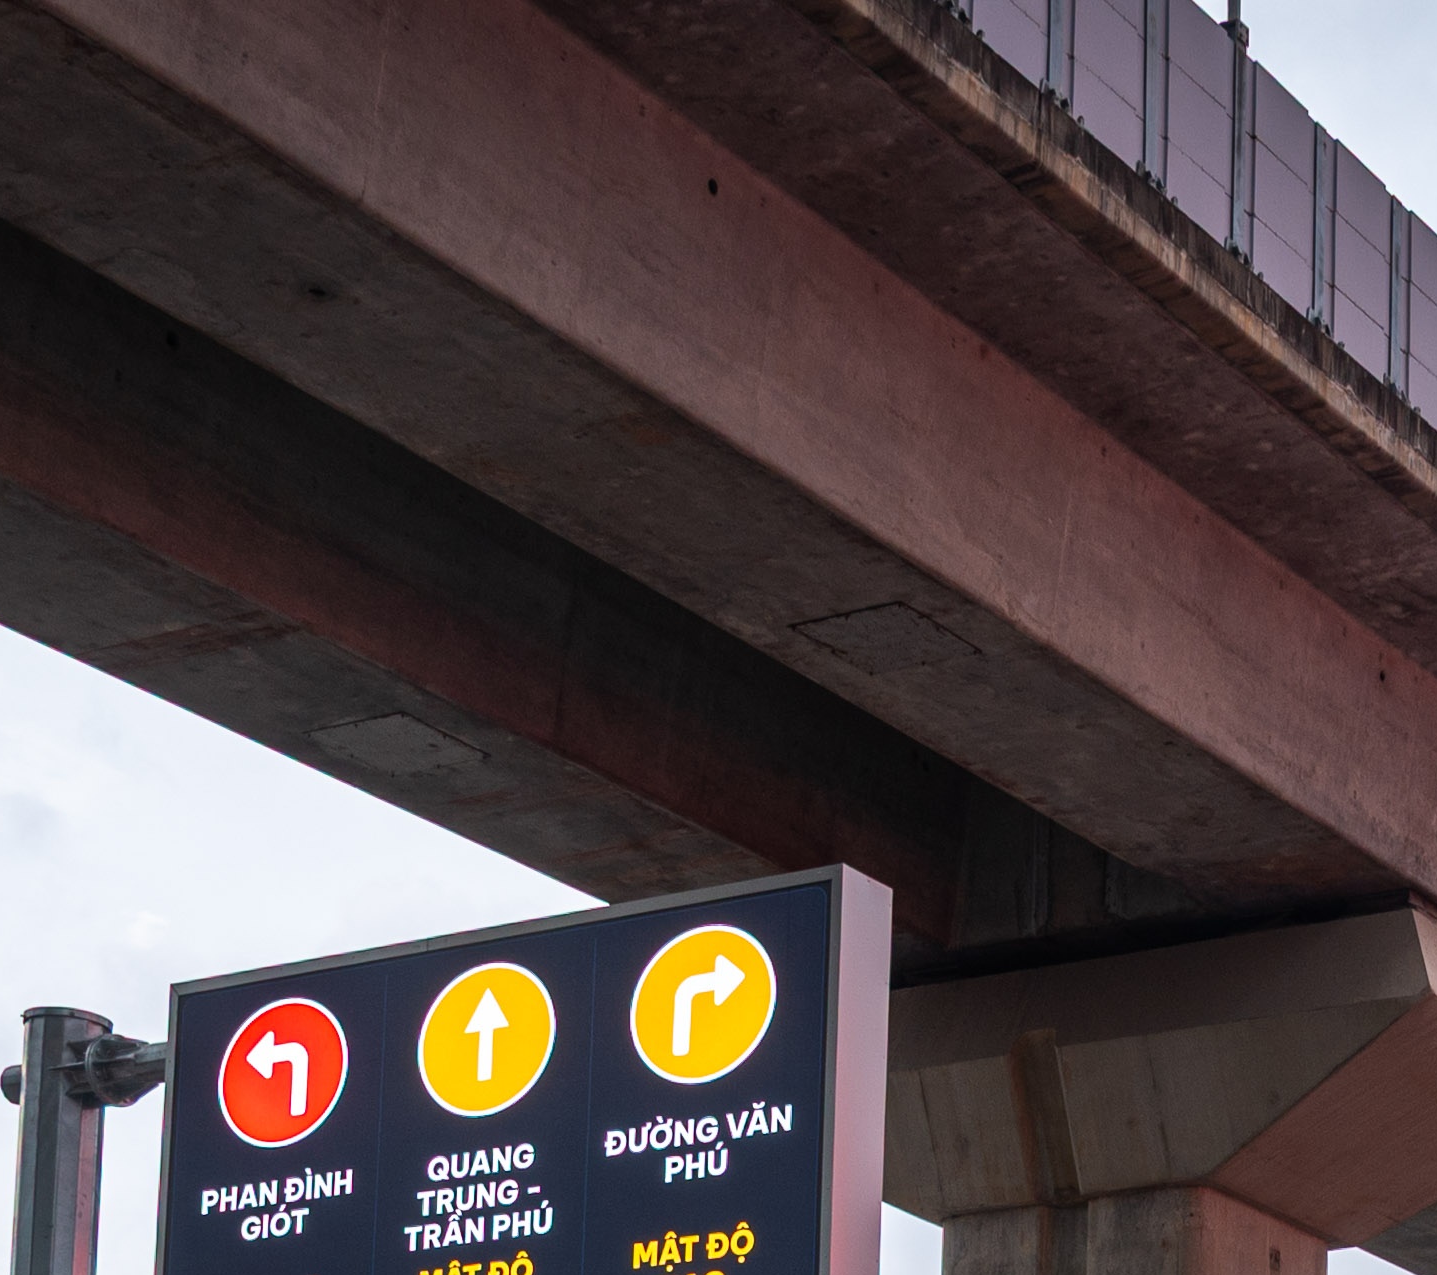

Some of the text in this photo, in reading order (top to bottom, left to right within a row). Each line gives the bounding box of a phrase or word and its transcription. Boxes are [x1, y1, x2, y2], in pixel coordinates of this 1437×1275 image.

[603, 1100, 794, 1158] ĐƯỜNG VĂN
[426, 1142, 536, 1182] QUANG
[663, 1141, 729, 1184] PHÚ
[201, 1168, 354, 1215] PHAN ĐÌNH
[416, 1179, 519, 1217] TRUNG
[240, 1202, 310, 1241] GIÓT
[403, 1200, 555, 1253] TRẦN PHÚ
[631, 1220, 756, 1272] MẬT ĐỘ
